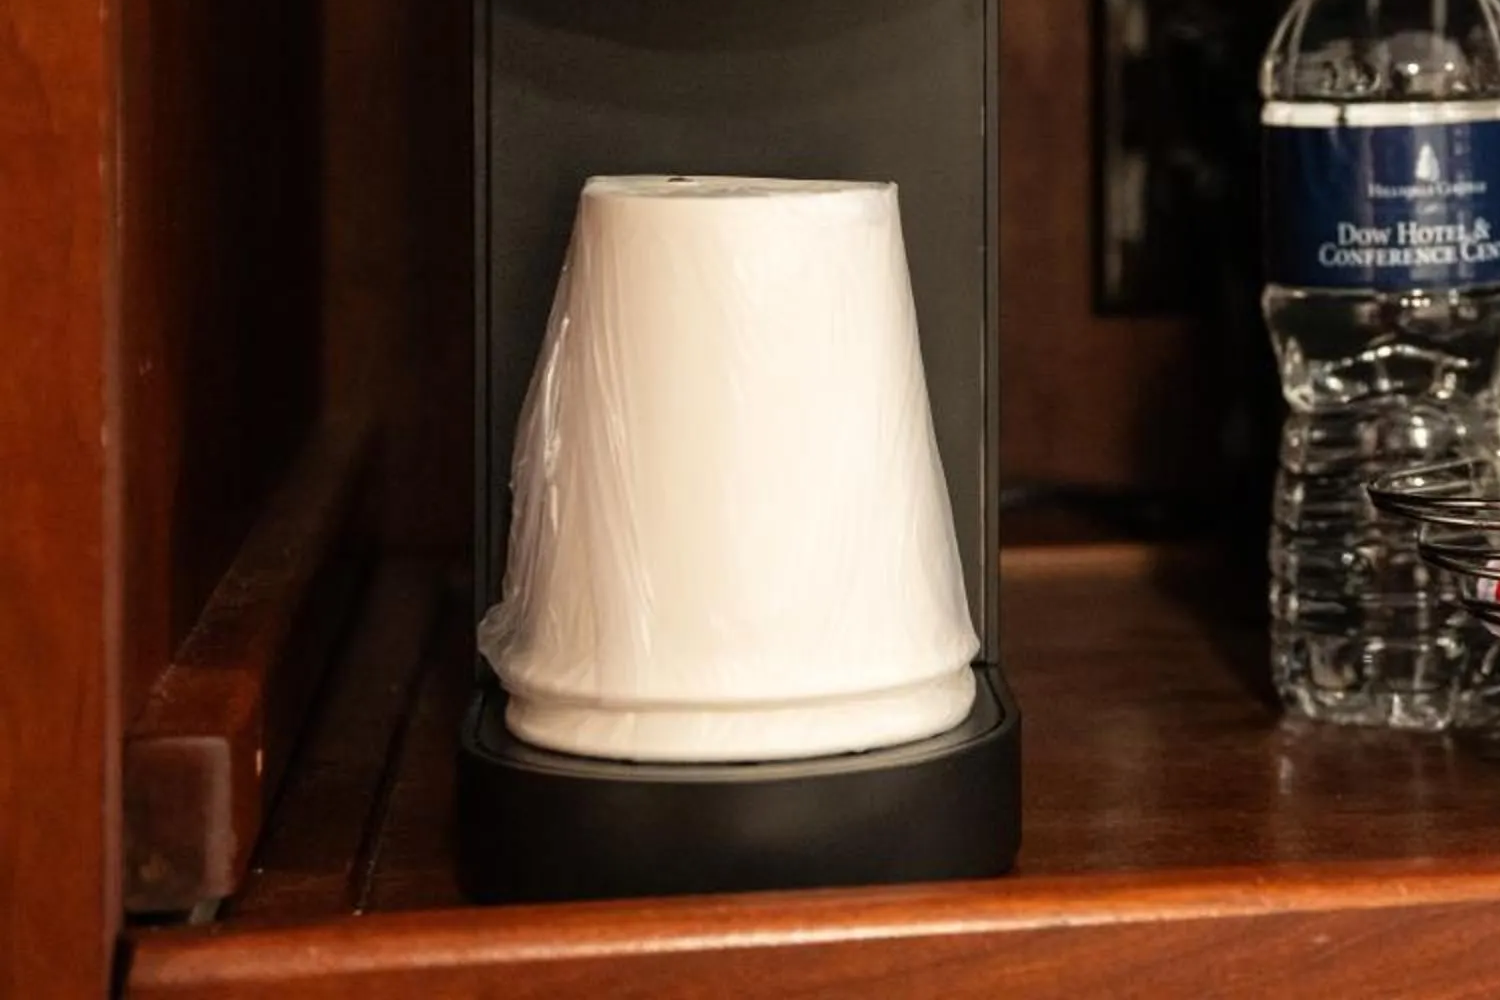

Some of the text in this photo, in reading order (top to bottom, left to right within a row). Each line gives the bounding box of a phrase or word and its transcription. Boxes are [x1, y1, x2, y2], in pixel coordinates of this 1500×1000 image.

[1338, 217, 1490, 246] DOW HOTEL &
[1318, 243, 1457, 267] CONFERENCE
